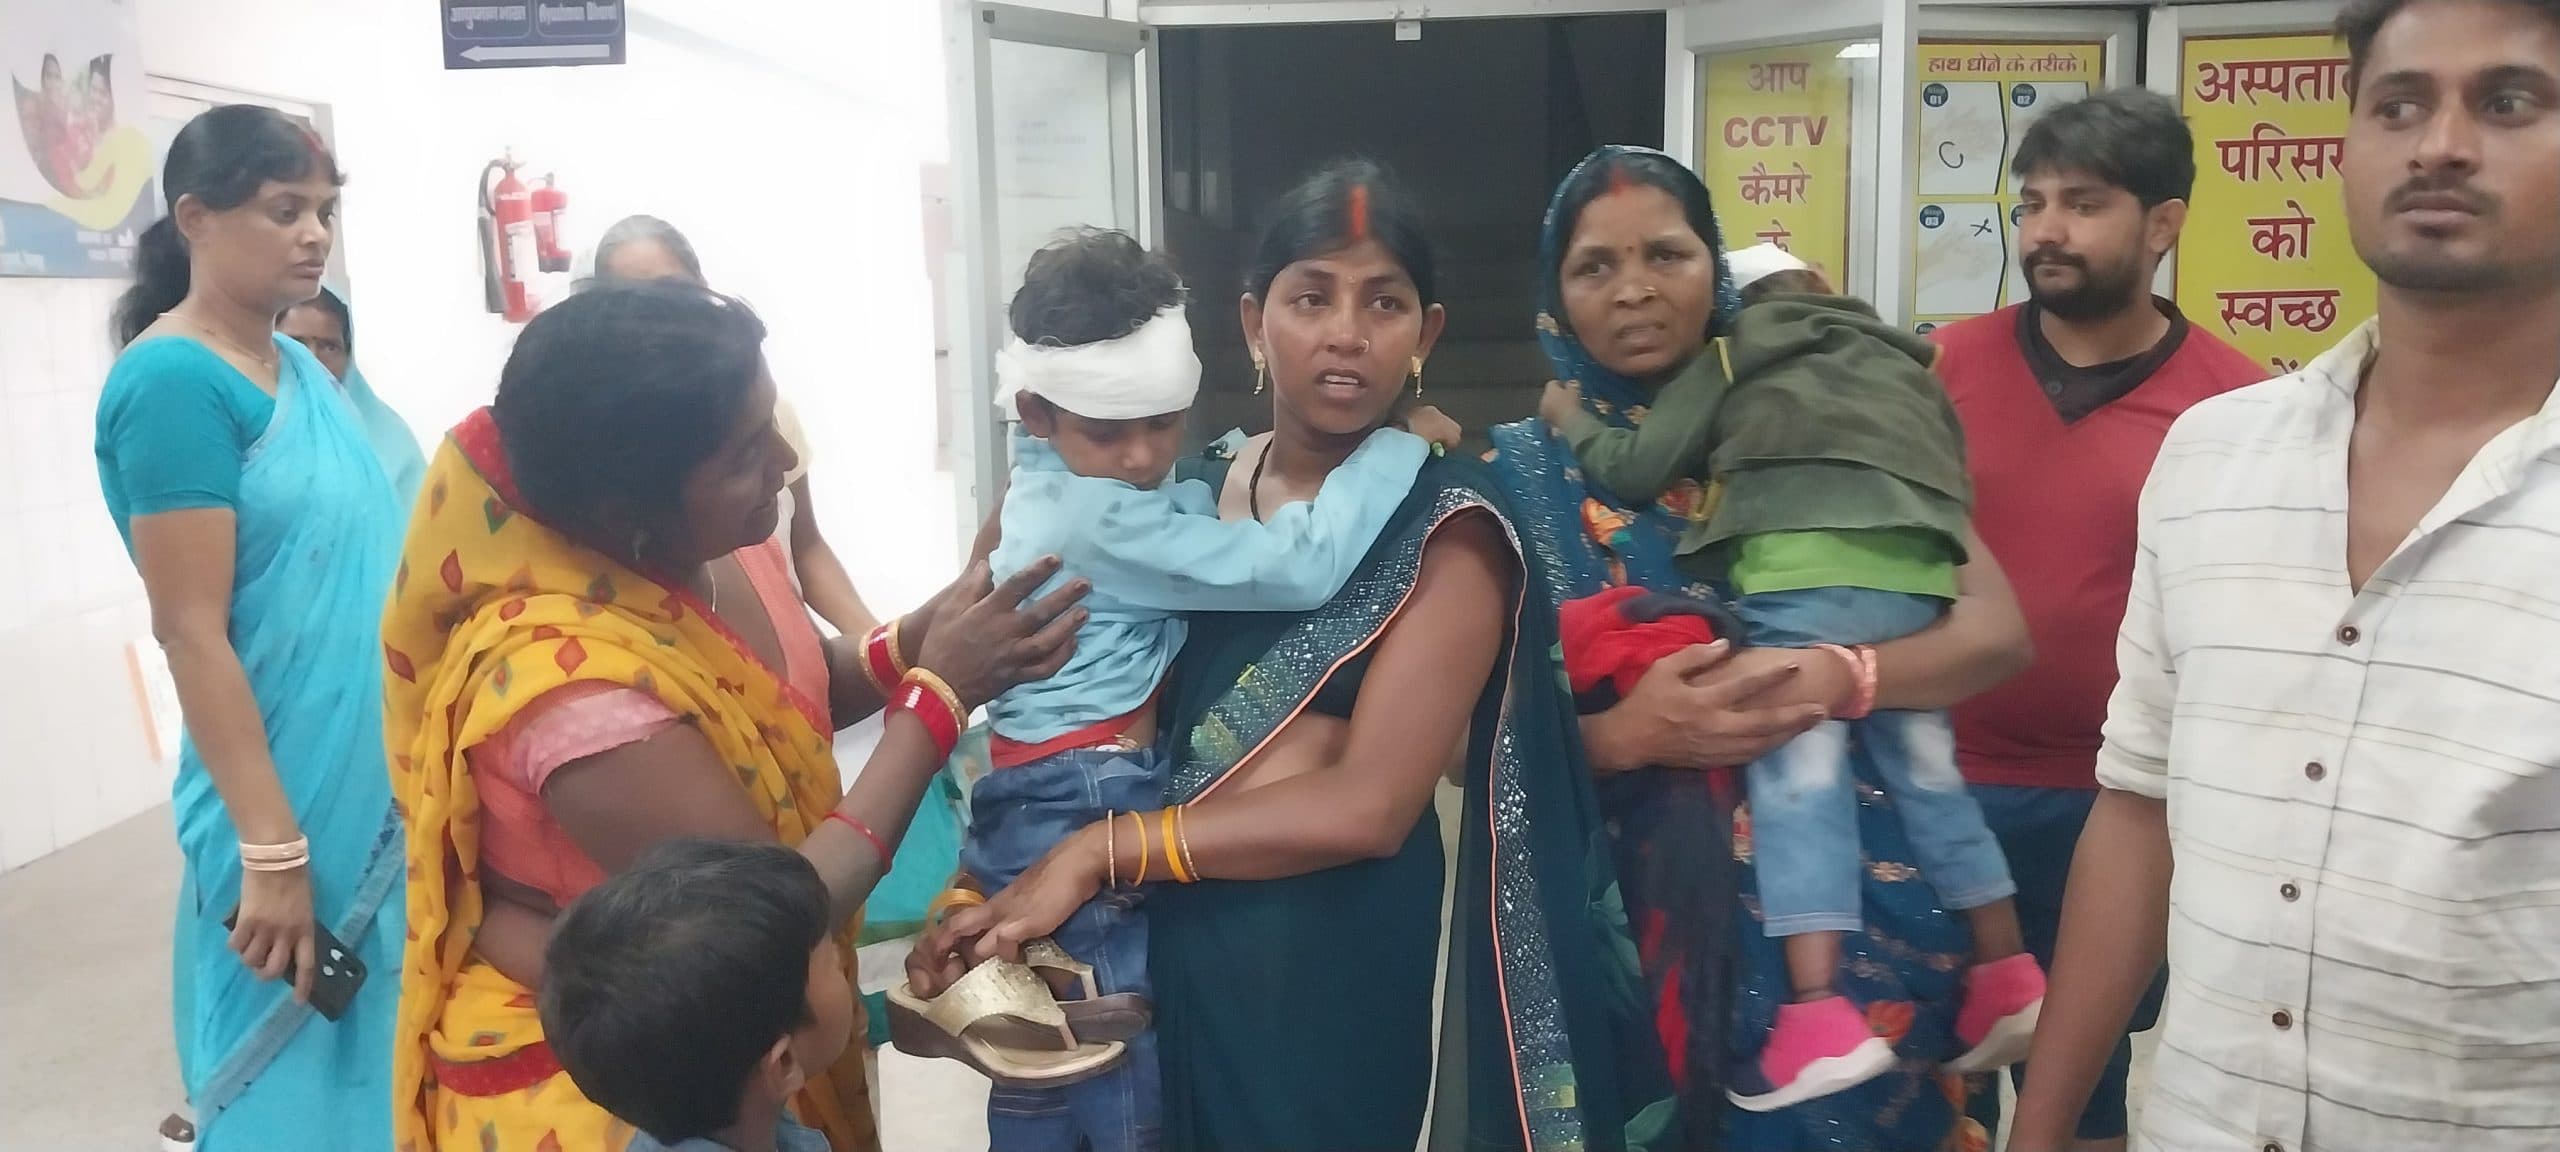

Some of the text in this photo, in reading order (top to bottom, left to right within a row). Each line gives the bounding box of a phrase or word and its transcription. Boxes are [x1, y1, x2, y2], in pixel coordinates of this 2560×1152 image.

[1747, 62, 1810, 92] आप
[1928, 57, 1961, 73] हाथ
[1967, 52, 2002, 73] धोने
[2006, 53, 2025, 73] के
[2030, 52, 2077, 73] तरीके
[2194, 57, 2351, 106] अस्पता
[1723, 115, 1828, 148] CCTV
[1738, 161, 1812, 205] कैमरे
[2247, 199, 2316, 261] को
[2216, 289, 2341, 336] स्वच्छ
